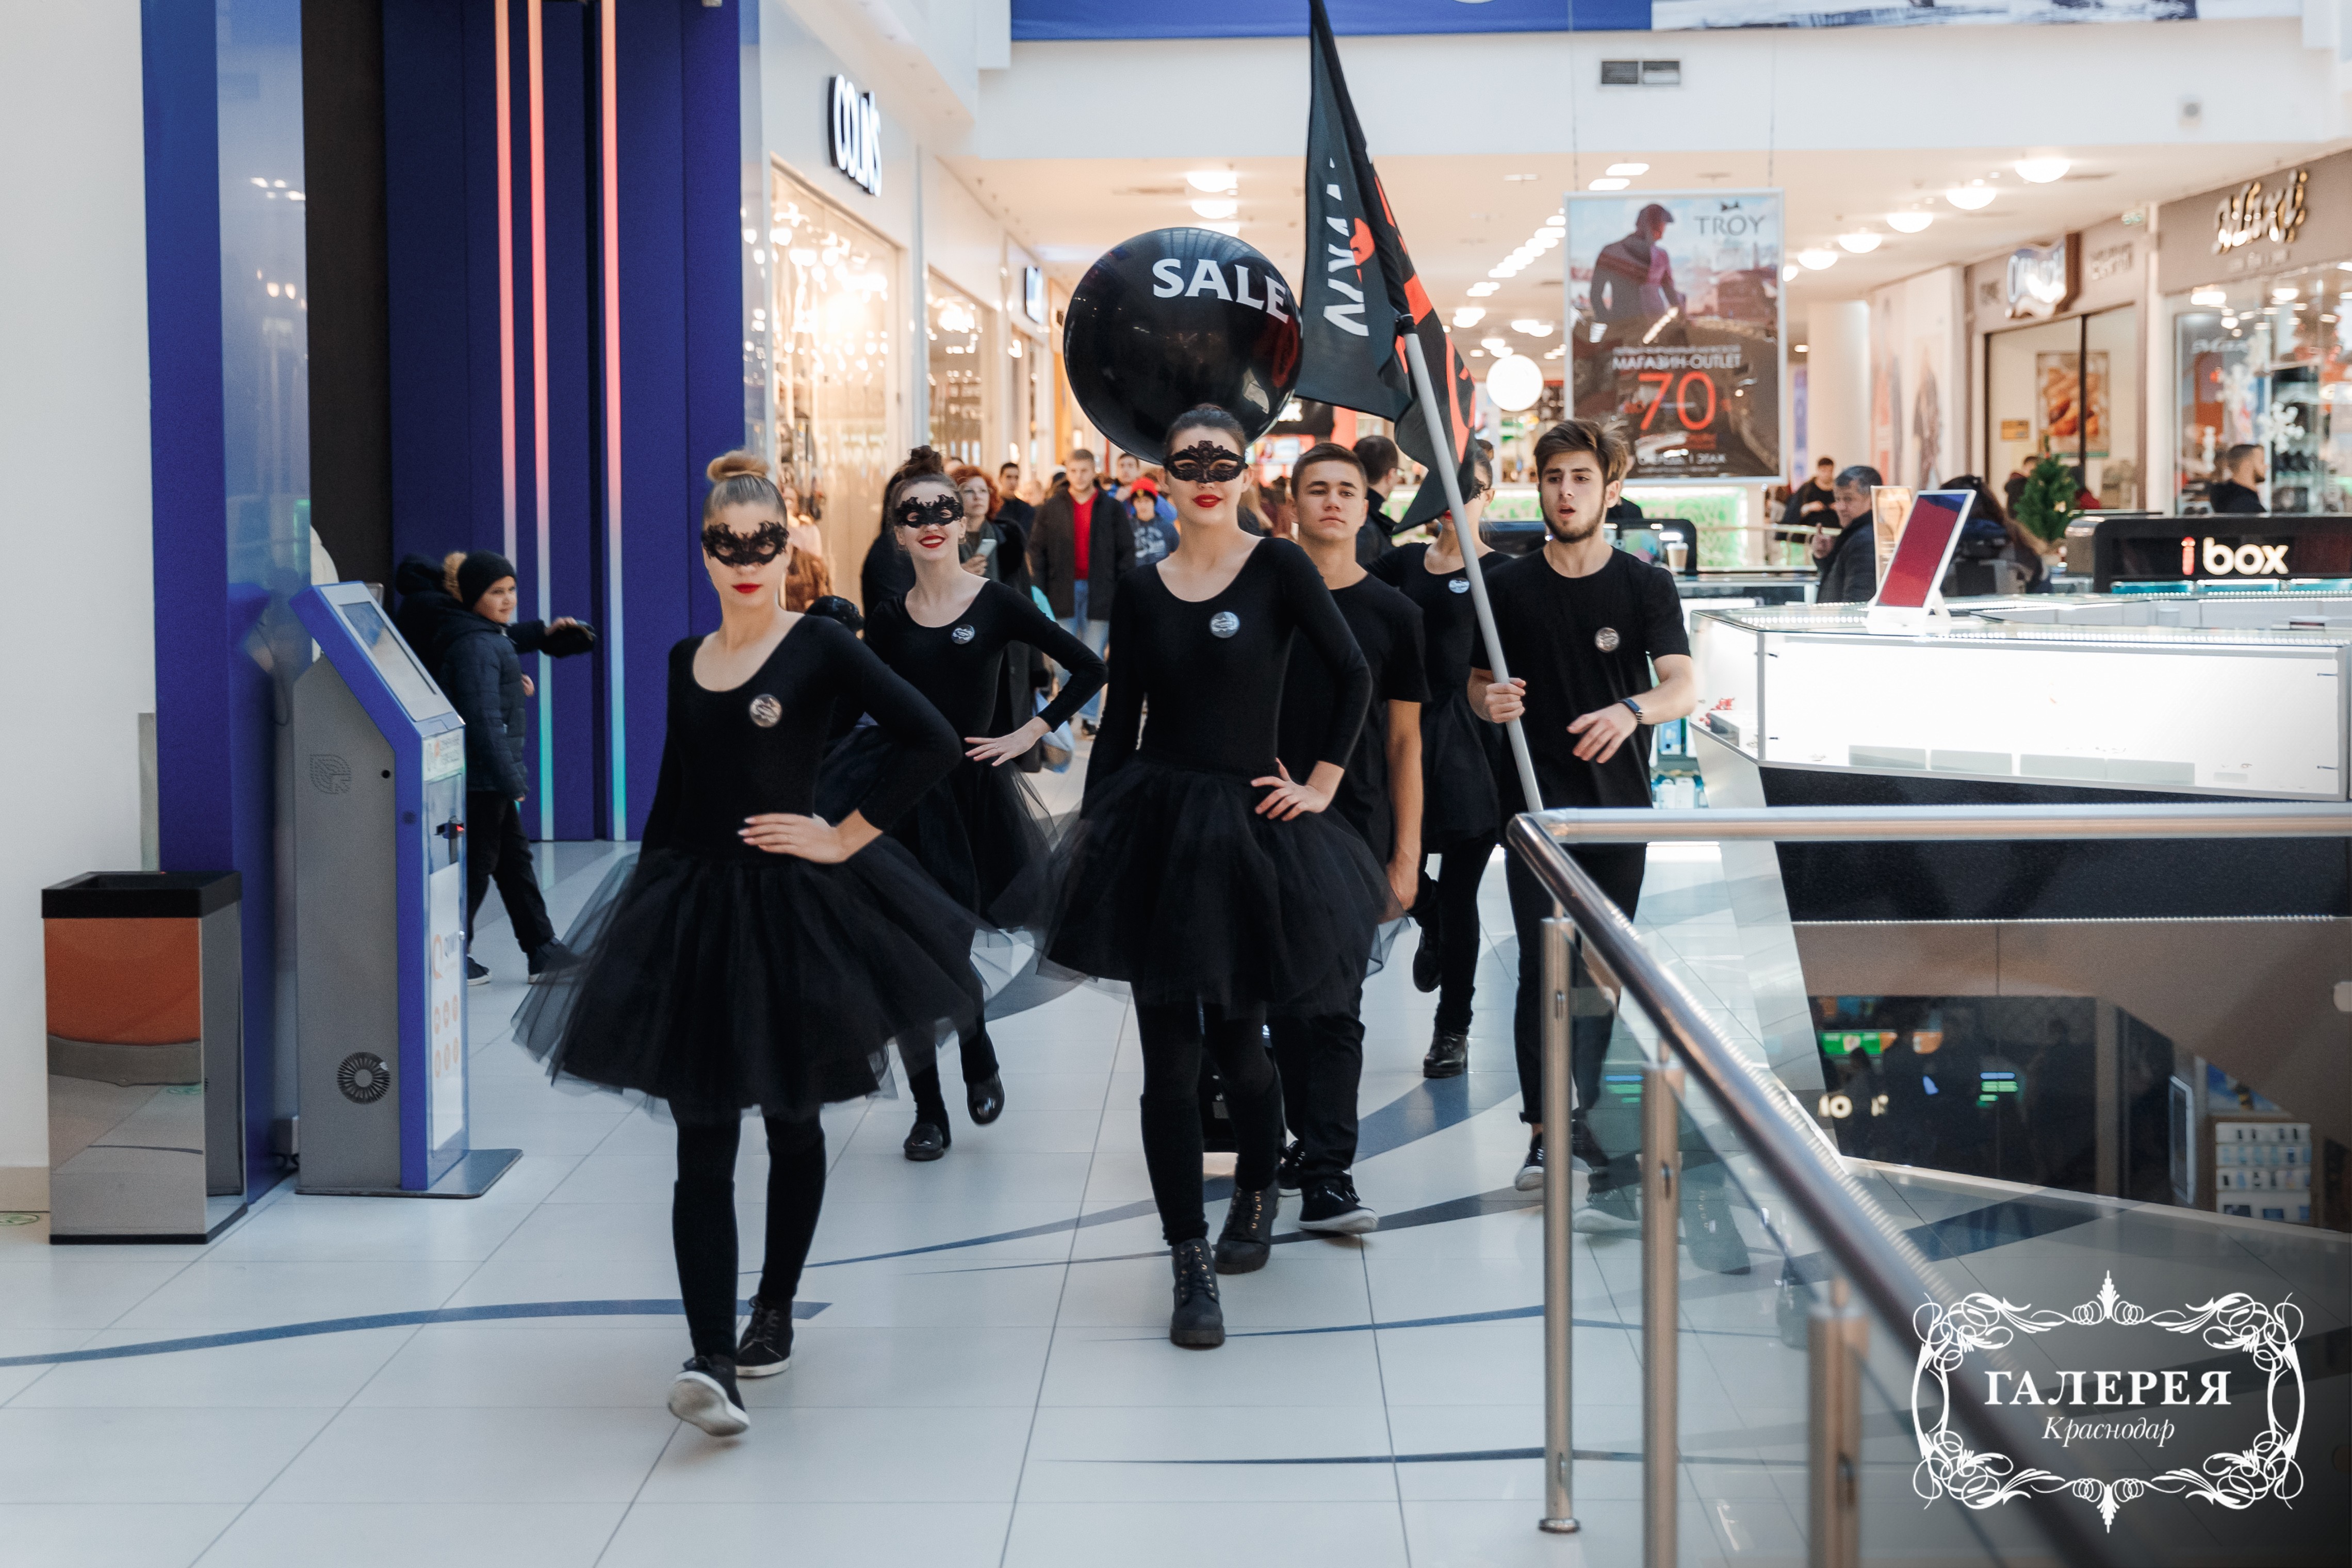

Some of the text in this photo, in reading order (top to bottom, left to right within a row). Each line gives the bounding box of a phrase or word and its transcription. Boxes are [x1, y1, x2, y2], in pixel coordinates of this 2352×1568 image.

[1693, 215, 1766, 235] TROY
[1152, 258, 1289, 324] SALE
[1638, 371, 1716, 430] 70
[2202, 537, 2289, 575] box
